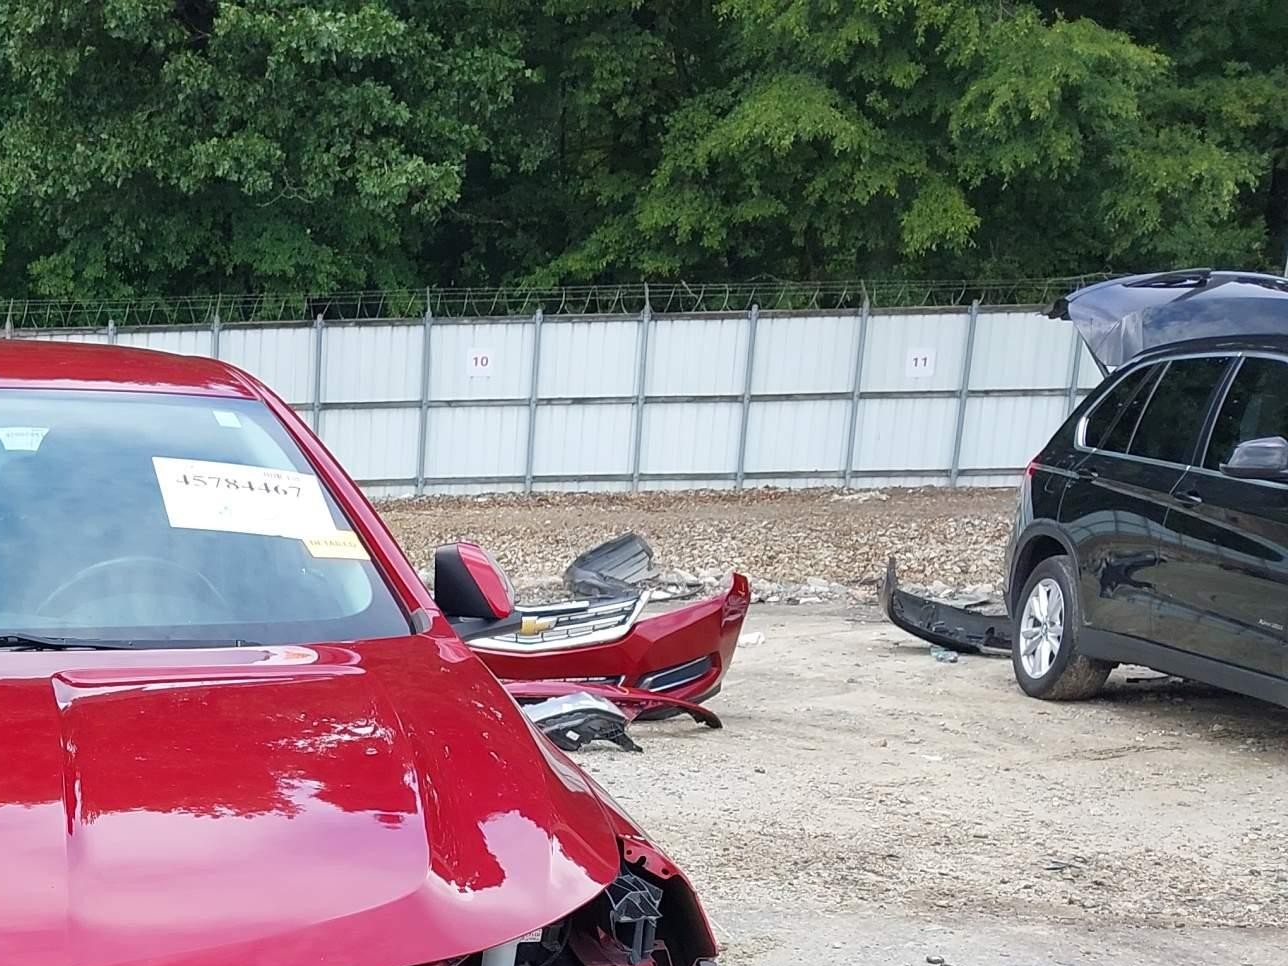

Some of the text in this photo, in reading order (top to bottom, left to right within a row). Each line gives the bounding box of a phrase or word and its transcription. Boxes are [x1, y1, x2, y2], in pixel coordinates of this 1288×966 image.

[473, 356, 489, 367] 10
[913, 357, 927, 367] 11
[176, 474, 301, 497] 45784467
